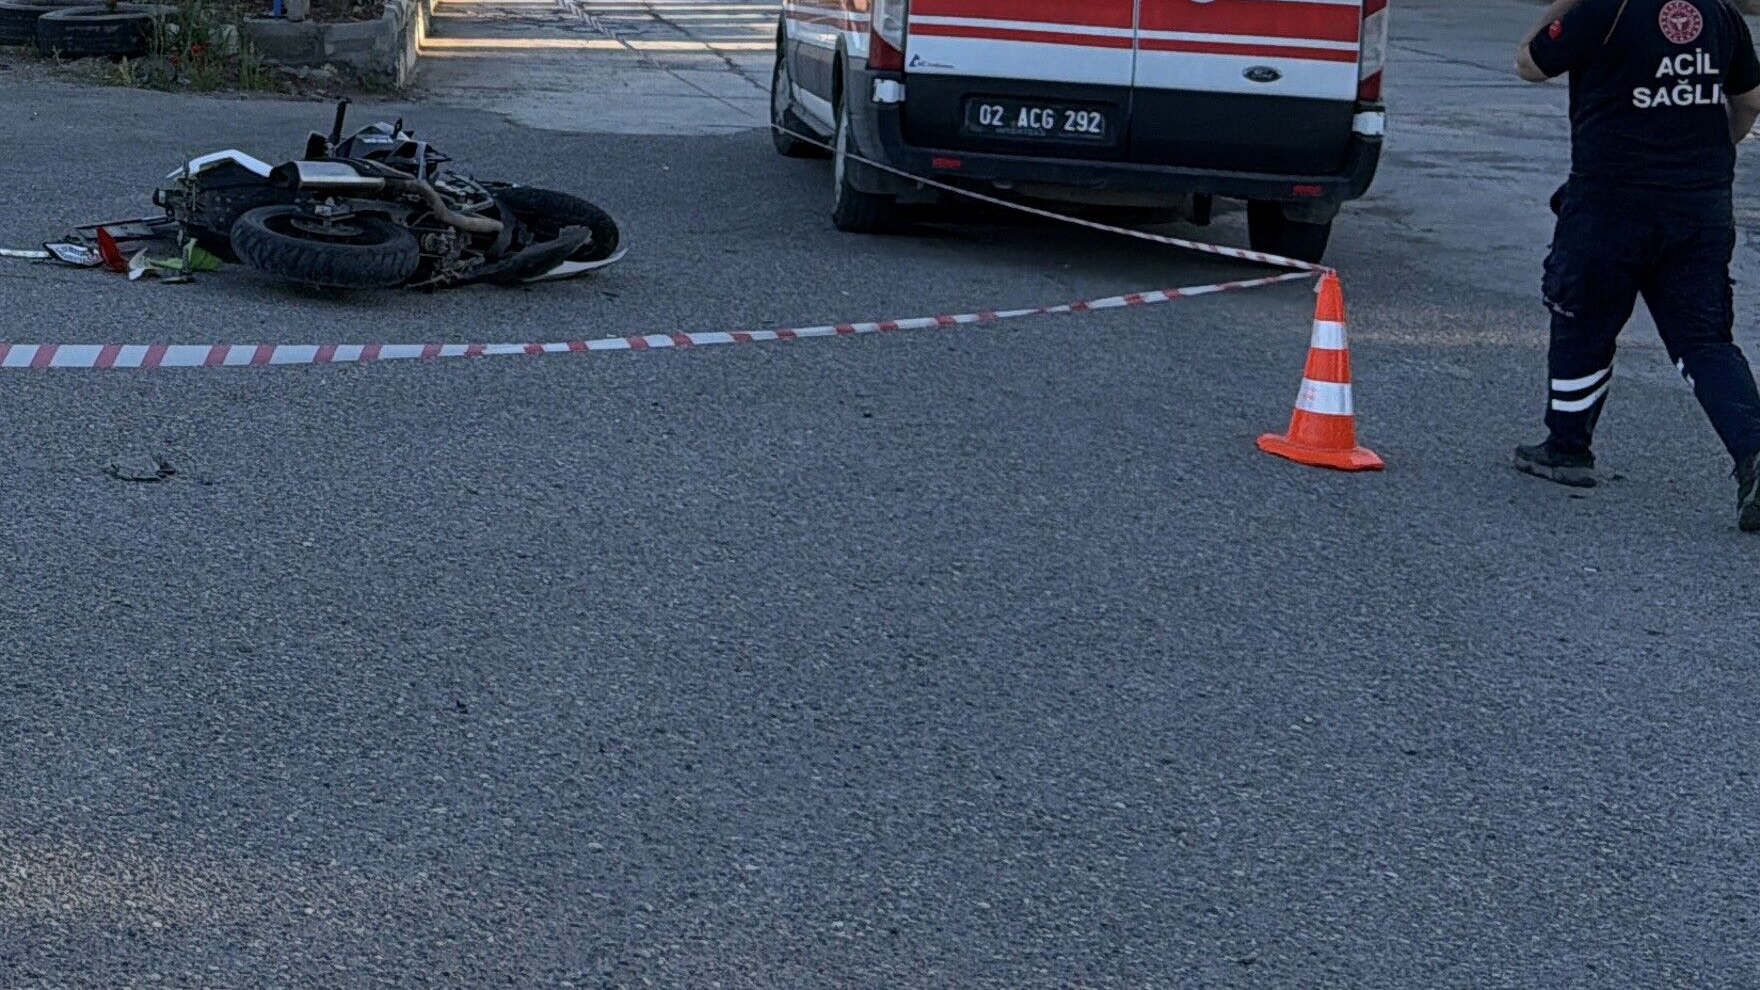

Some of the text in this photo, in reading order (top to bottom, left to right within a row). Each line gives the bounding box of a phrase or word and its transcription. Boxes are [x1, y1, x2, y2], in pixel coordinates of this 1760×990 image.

[1655, 48, 1720, 78] ACİL
[979, 104, 1004, 127] 02
[1016, 106, 1055, 130] ACG
[1062, 110, 1102, 134] 292
